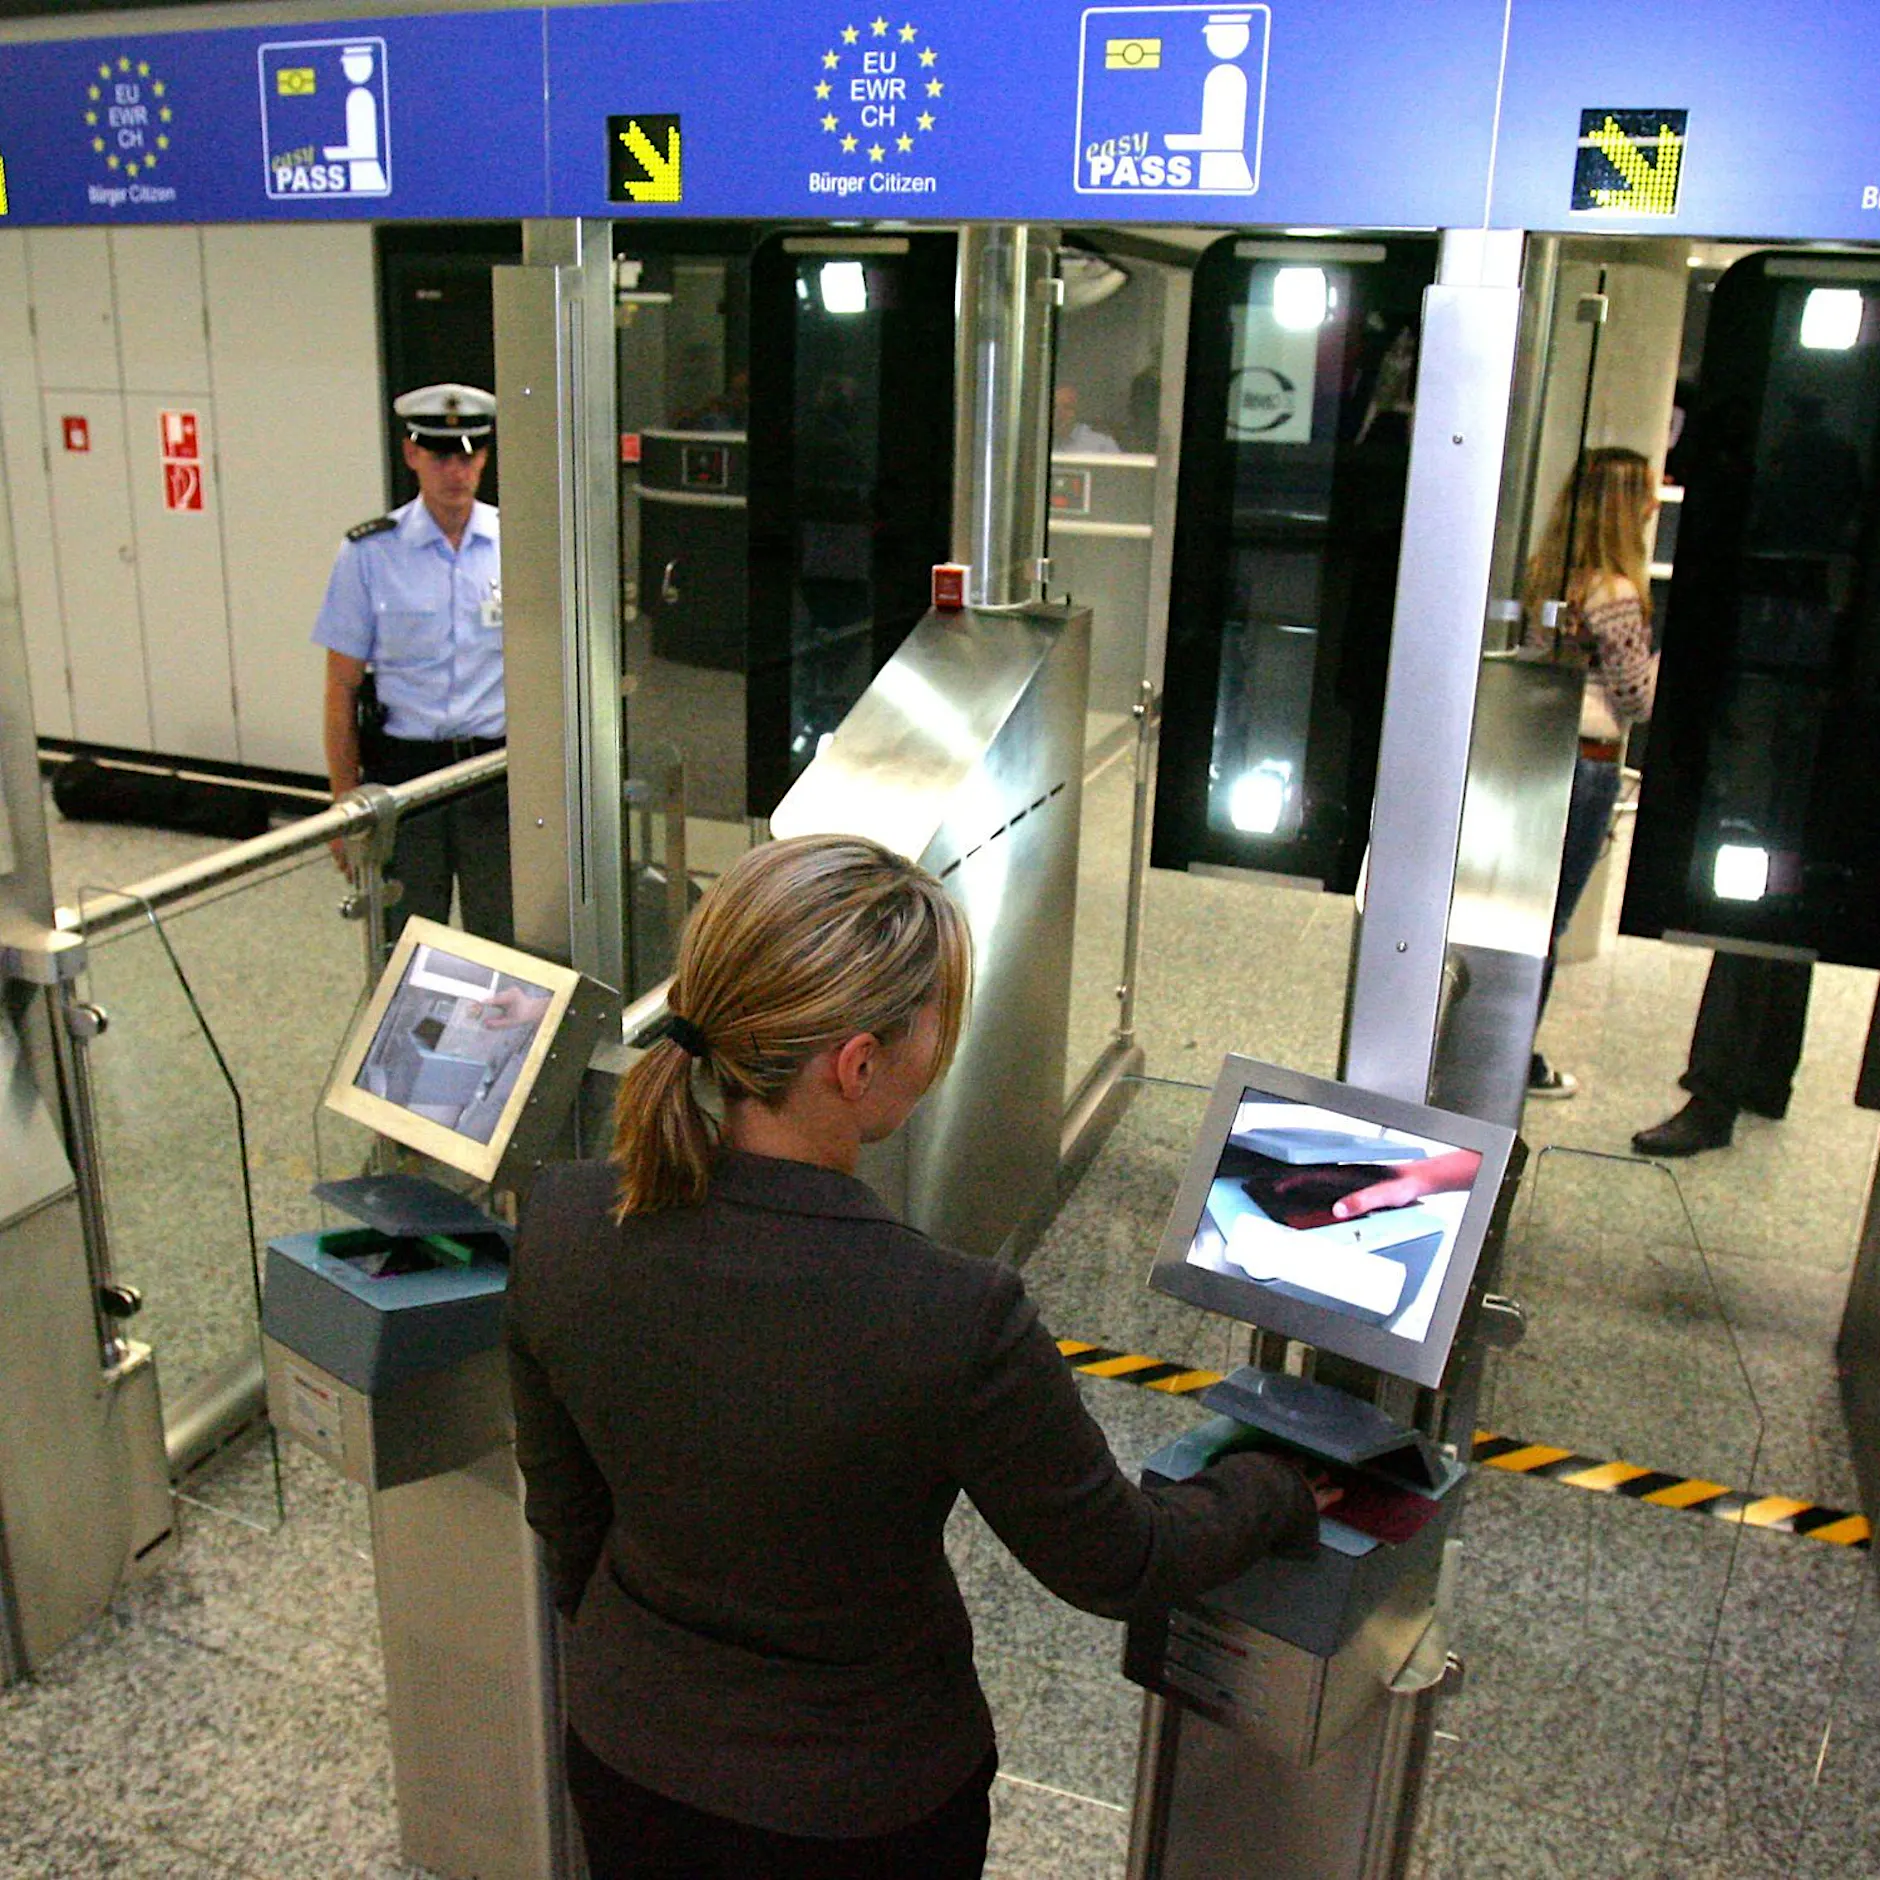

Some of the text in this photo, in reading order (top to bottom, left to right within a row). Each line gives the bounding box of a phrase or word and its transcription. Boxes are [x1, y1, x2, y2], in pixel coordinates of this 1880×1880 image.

[864, 51, 896, 74] EU
[115, 83, 140, 104] EU
[851, 78, 906, 101] EWR
[109, 105, 148, 127] EWR
[861, 105, 895, 127] CH
[117, 128, 144, 149] CH
[1086, 131, 1148, 162] easy
[276, 164, 345, 192] PASS
[1090, 155, 1192, 187] PASS
[128, 184, 176, 204] Citizen
[809, 171, 936, 196] Bürger Citizen
[1862, 186, 1880, 209] B
